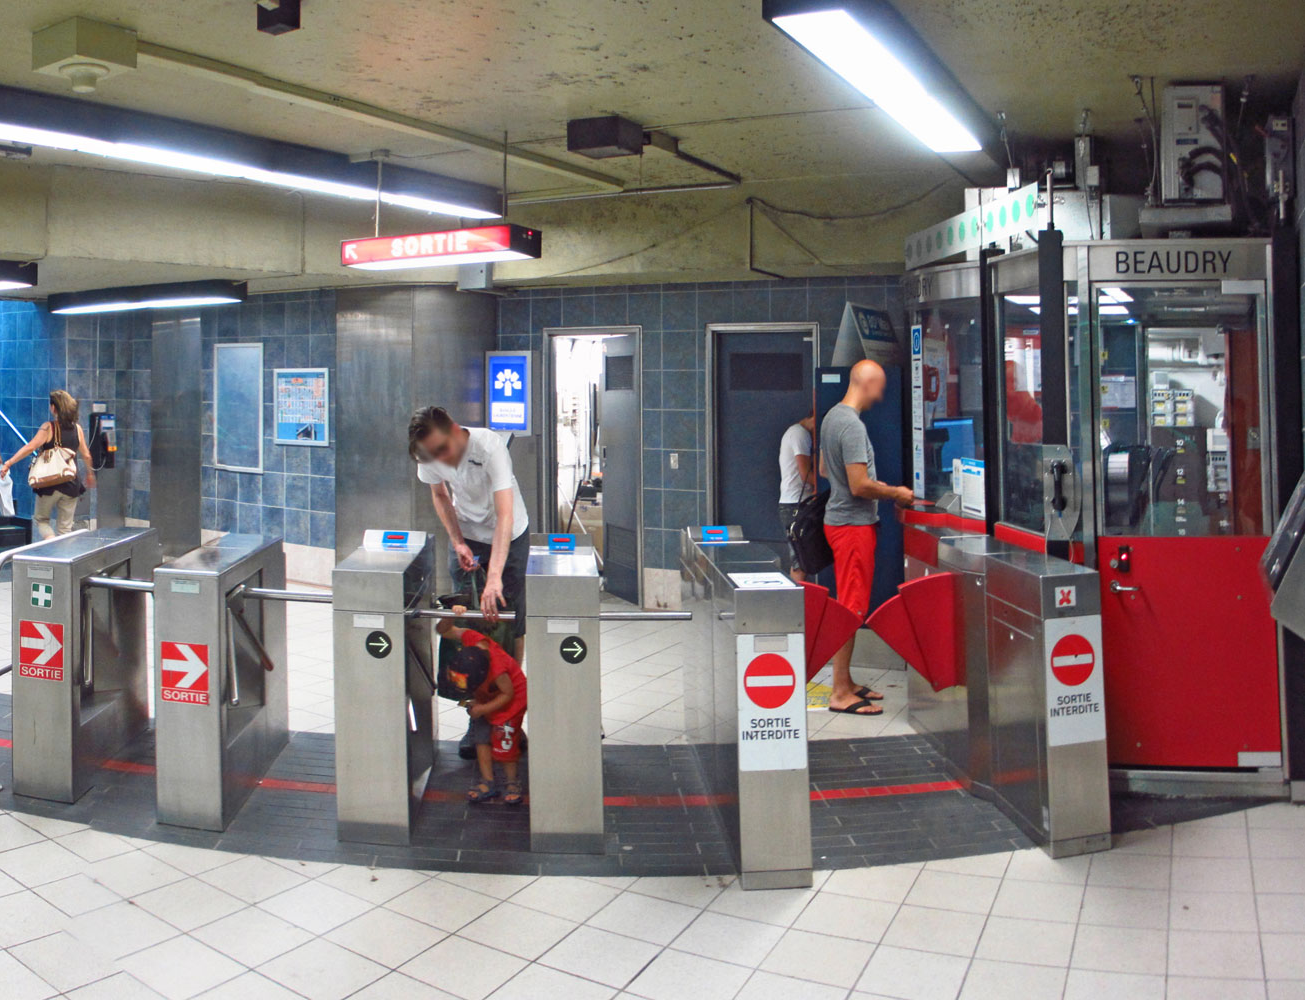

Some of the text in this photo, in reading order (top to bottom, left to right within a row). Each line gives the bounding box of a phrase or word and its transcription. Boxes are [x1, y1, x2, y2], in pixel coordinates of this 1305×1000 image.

[391, 231, 468, 257] SORTIE
[1115, 250, 1232, 274] BEAUDRY
[21, 666, 62, 679] SORTIE
[163, 690, 208, 703] SORTIE
[1056, 692, 1092, 706] SORTIE
[1050, 703, 1100, 717] INTERDITE
[750, 717, 791, 728] SORTIE
[742, 729, 800, 740] INTERDITE
